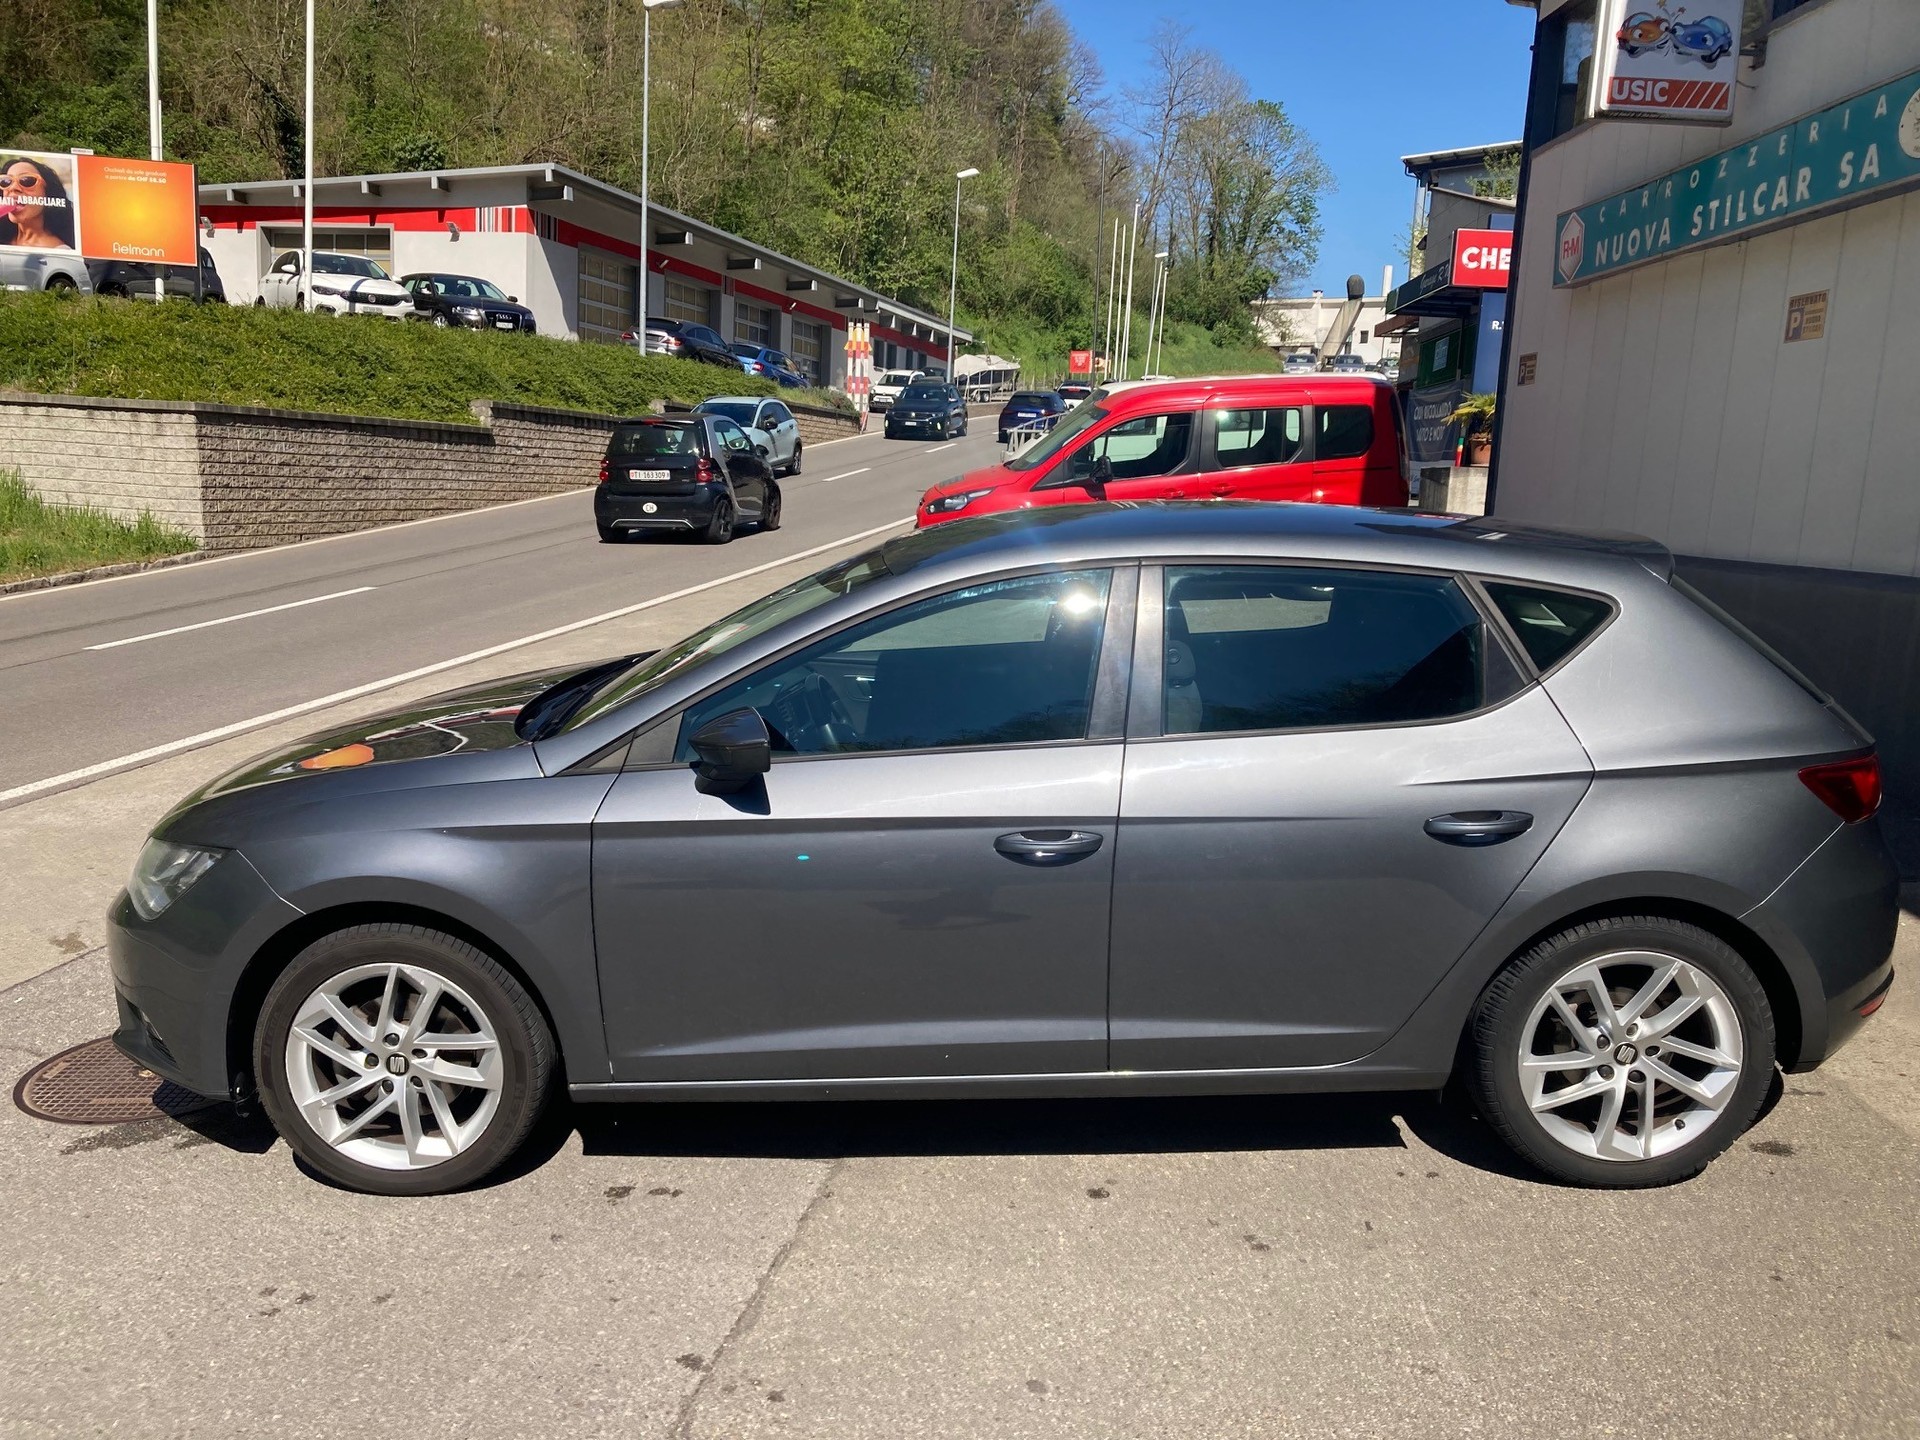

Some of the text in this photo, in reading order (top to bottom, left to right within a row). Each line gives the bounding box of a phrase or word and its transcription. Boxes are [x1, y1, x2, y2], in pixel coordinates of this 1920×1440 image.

[1611, 79, 1669, 102] USIC
[1600, 94, 1887, 223] CARROZZERIA
[17, 195, 66, 207] ABBAGLIARE
[1595, 143, 1880, 267] NUOVA STILCAR SA
